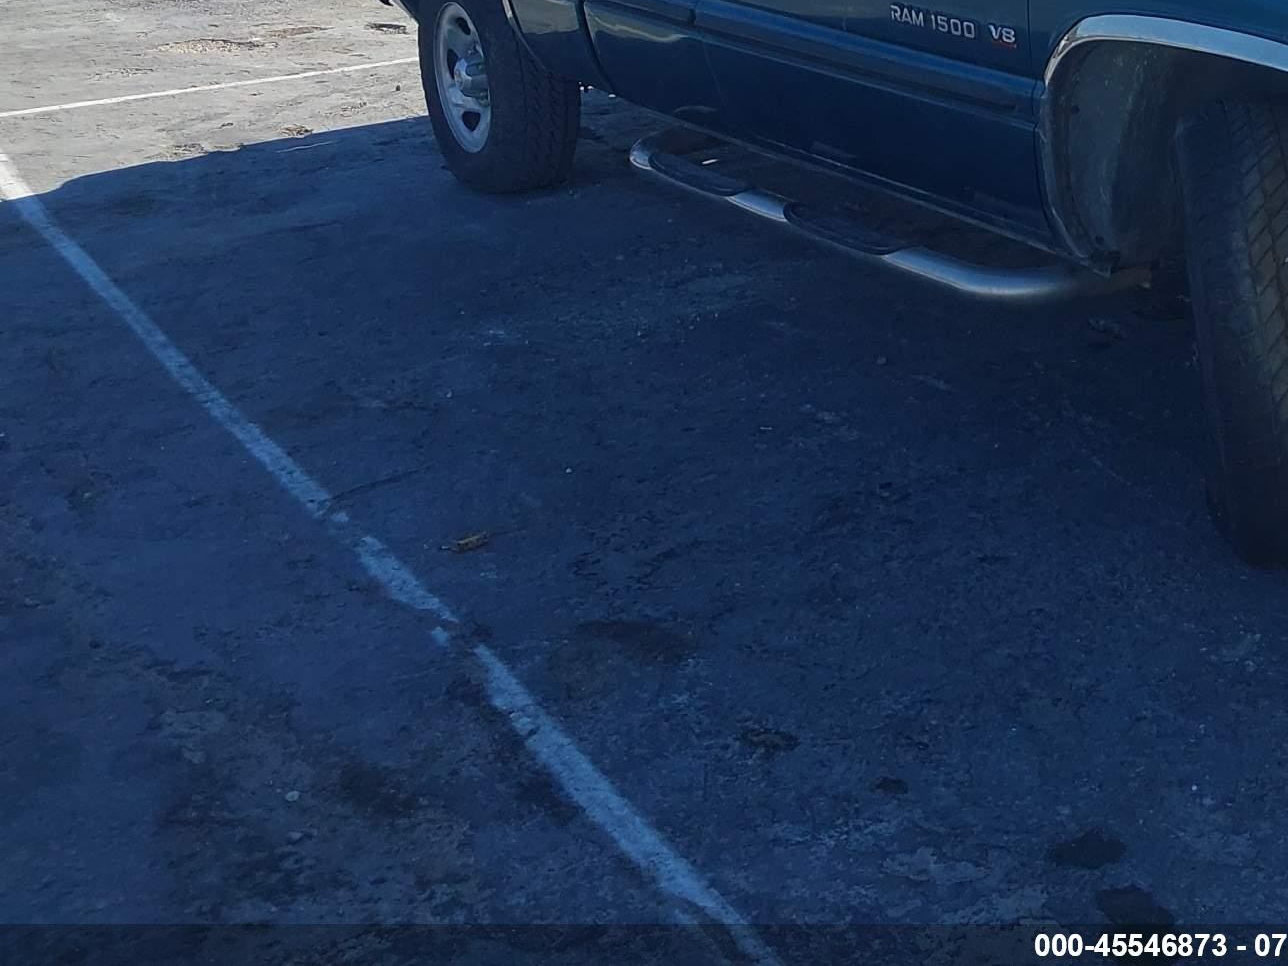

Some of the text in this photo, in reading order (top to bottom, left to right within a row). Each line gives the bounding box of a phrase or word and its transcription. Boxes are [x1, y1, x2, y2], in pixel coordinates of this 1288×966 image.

[890, 4, 1016, 44] RAM 1500 V8
